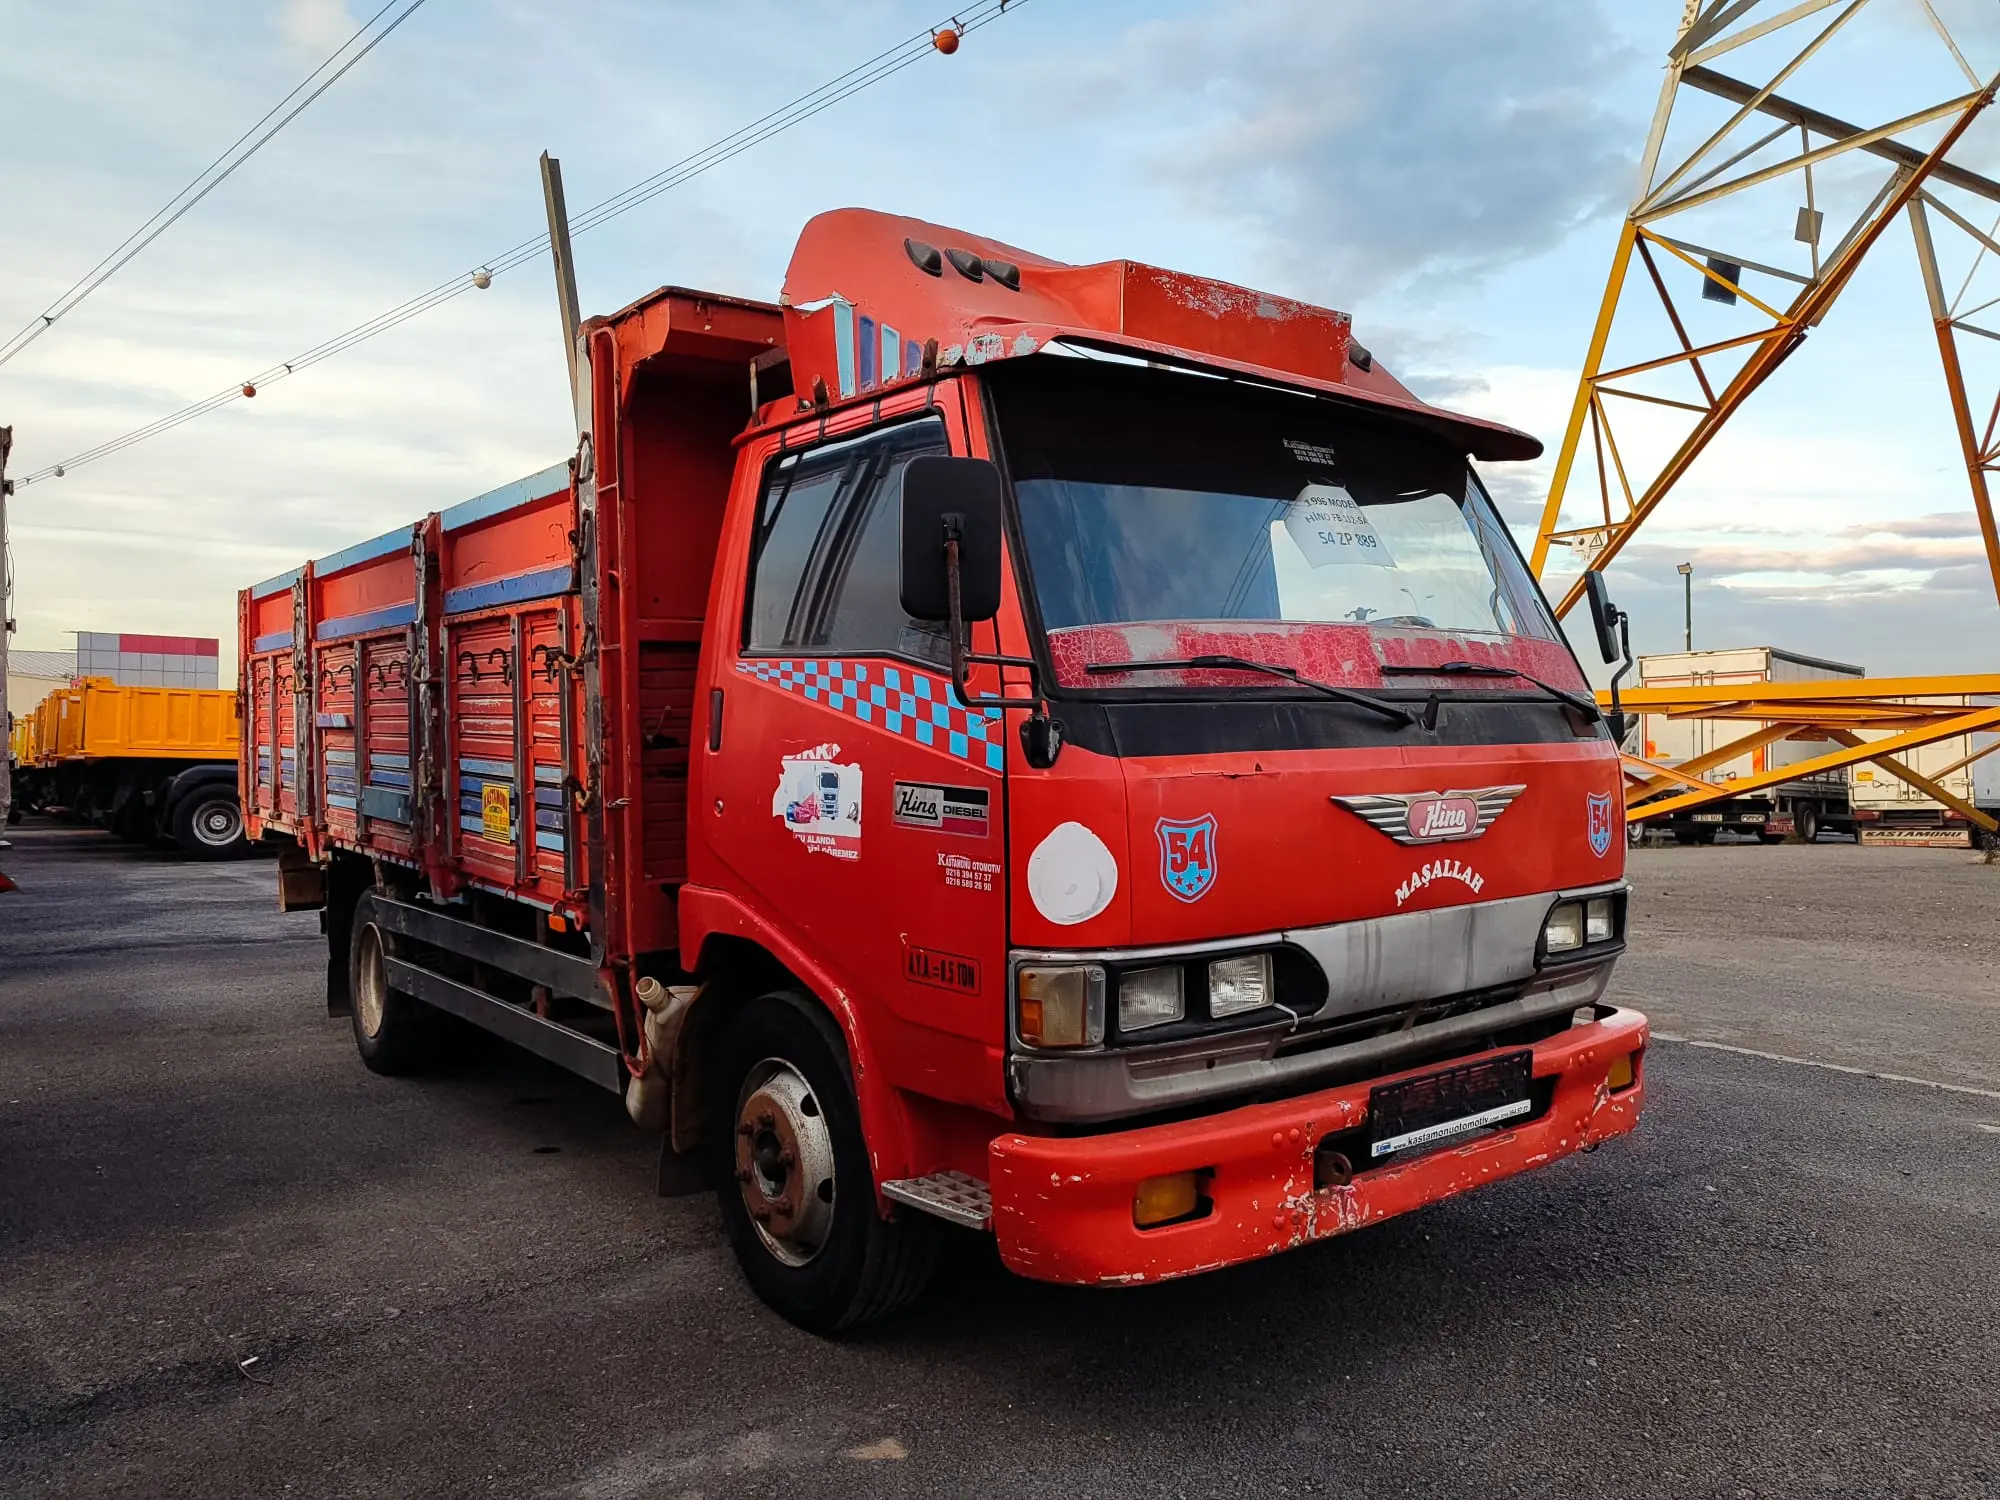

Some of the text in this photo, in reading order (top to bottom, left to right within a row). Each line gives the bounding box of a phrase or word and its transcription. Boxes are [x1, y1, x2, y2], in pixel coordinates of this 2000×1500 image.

[1328, 498, 1358, 509] MODEL
[1318, 531, 1336, 545] 54
[1336, 532, 1353, 546] ZP
[895, 788, 988, 820] Hino DIESEL
[1419, 801, 1467, 837] Hino
[1592, 804, 1609, 835] 54
[807, 835, 836, 845] ALANDA
[1167, 829, 1209, 874] 54
[945, 868, 992, 882] 0216 394 57 37
[945, 877, 961, 887] 0216
[983, 883, 992, 892] 90
[1395, 859, 1485, 907] MAŞALLAH
[957, 962, 975, 989] TON
